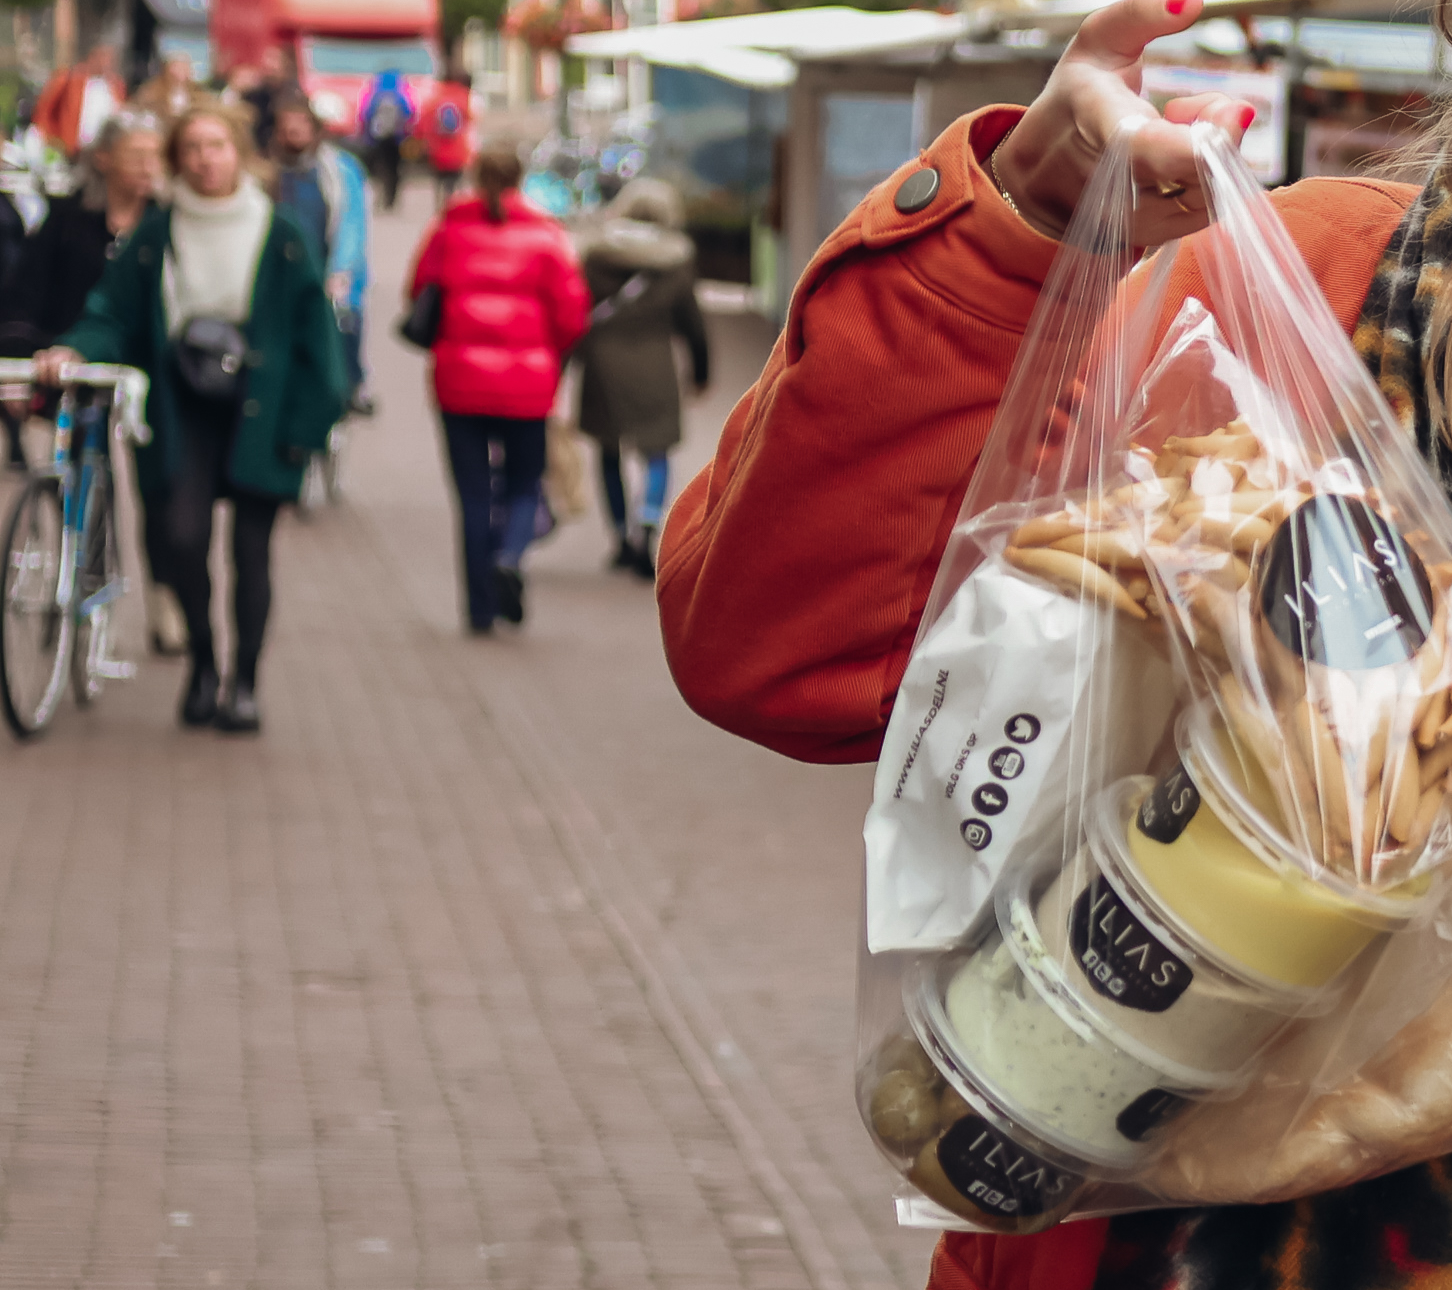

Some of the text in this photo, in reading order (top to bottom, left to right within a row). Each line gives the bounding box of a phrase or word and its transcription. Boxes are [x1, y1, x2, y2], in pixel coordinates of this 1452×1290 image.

[1284, 538, 1398, 617] ILIAS
[944, 731, 978, 800] VOLG ONS OP
[1091, 892, 1177, 987] ILIAS
[968, 1130, 1071, 1194] ILIAS
